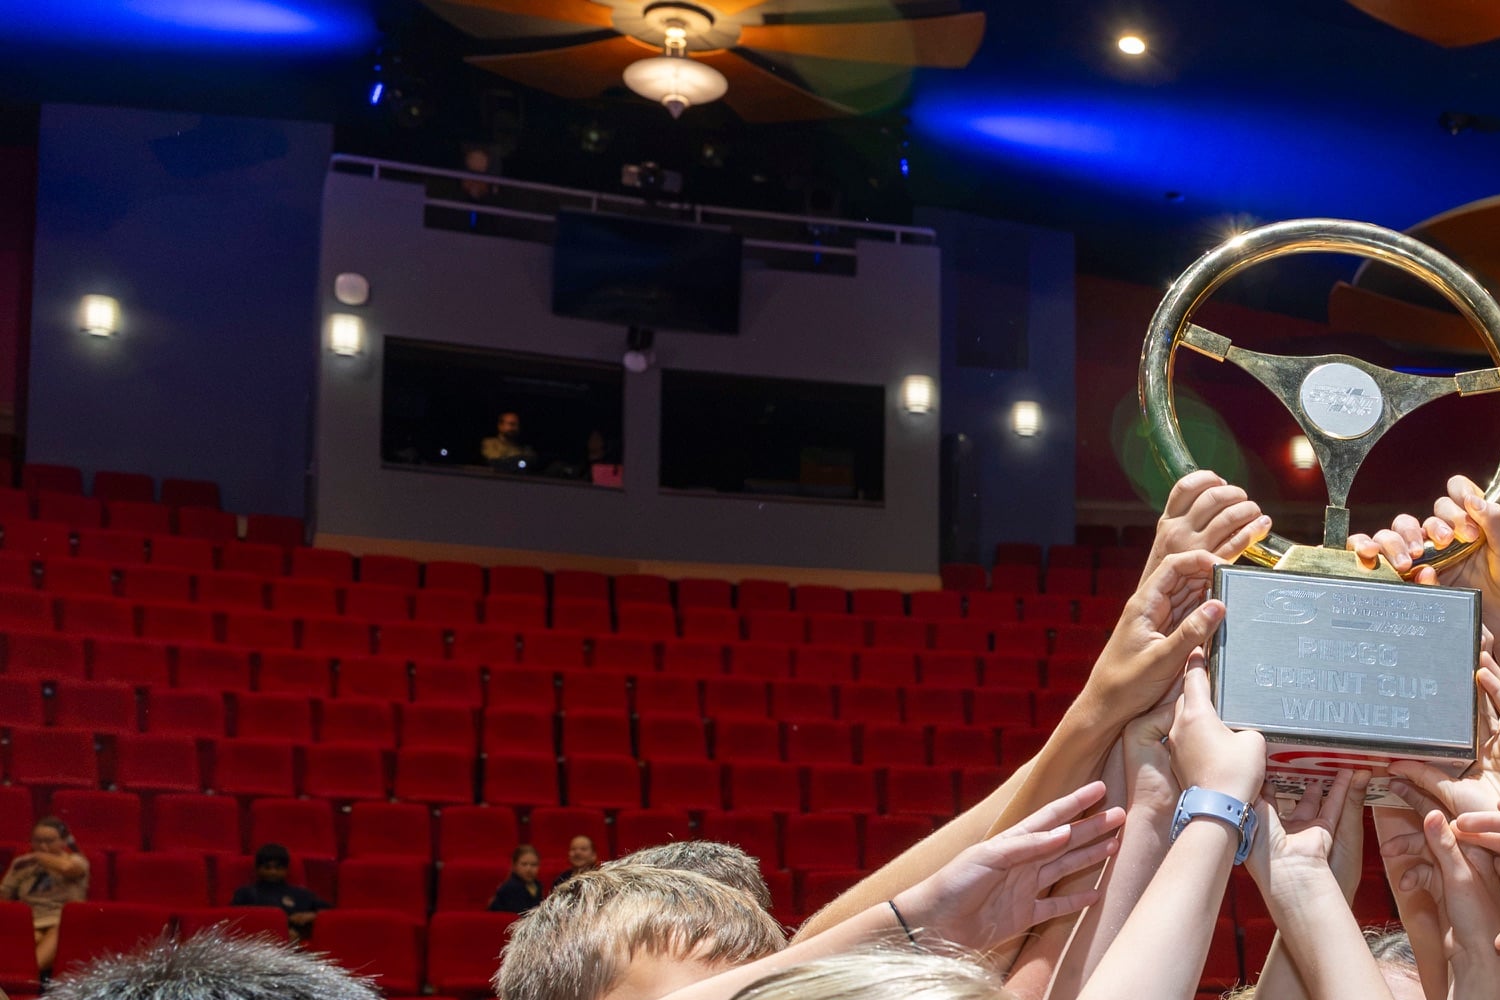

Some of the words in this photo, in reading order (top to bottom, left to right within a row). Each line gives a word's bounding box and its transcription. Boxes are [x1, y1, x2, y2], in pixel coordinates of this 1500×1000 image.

[1254, 663, 1369, 695] SPRINT
[1376, 673, 1440, 700] CUP
[1280, 696, 1411, 729] WINNER
